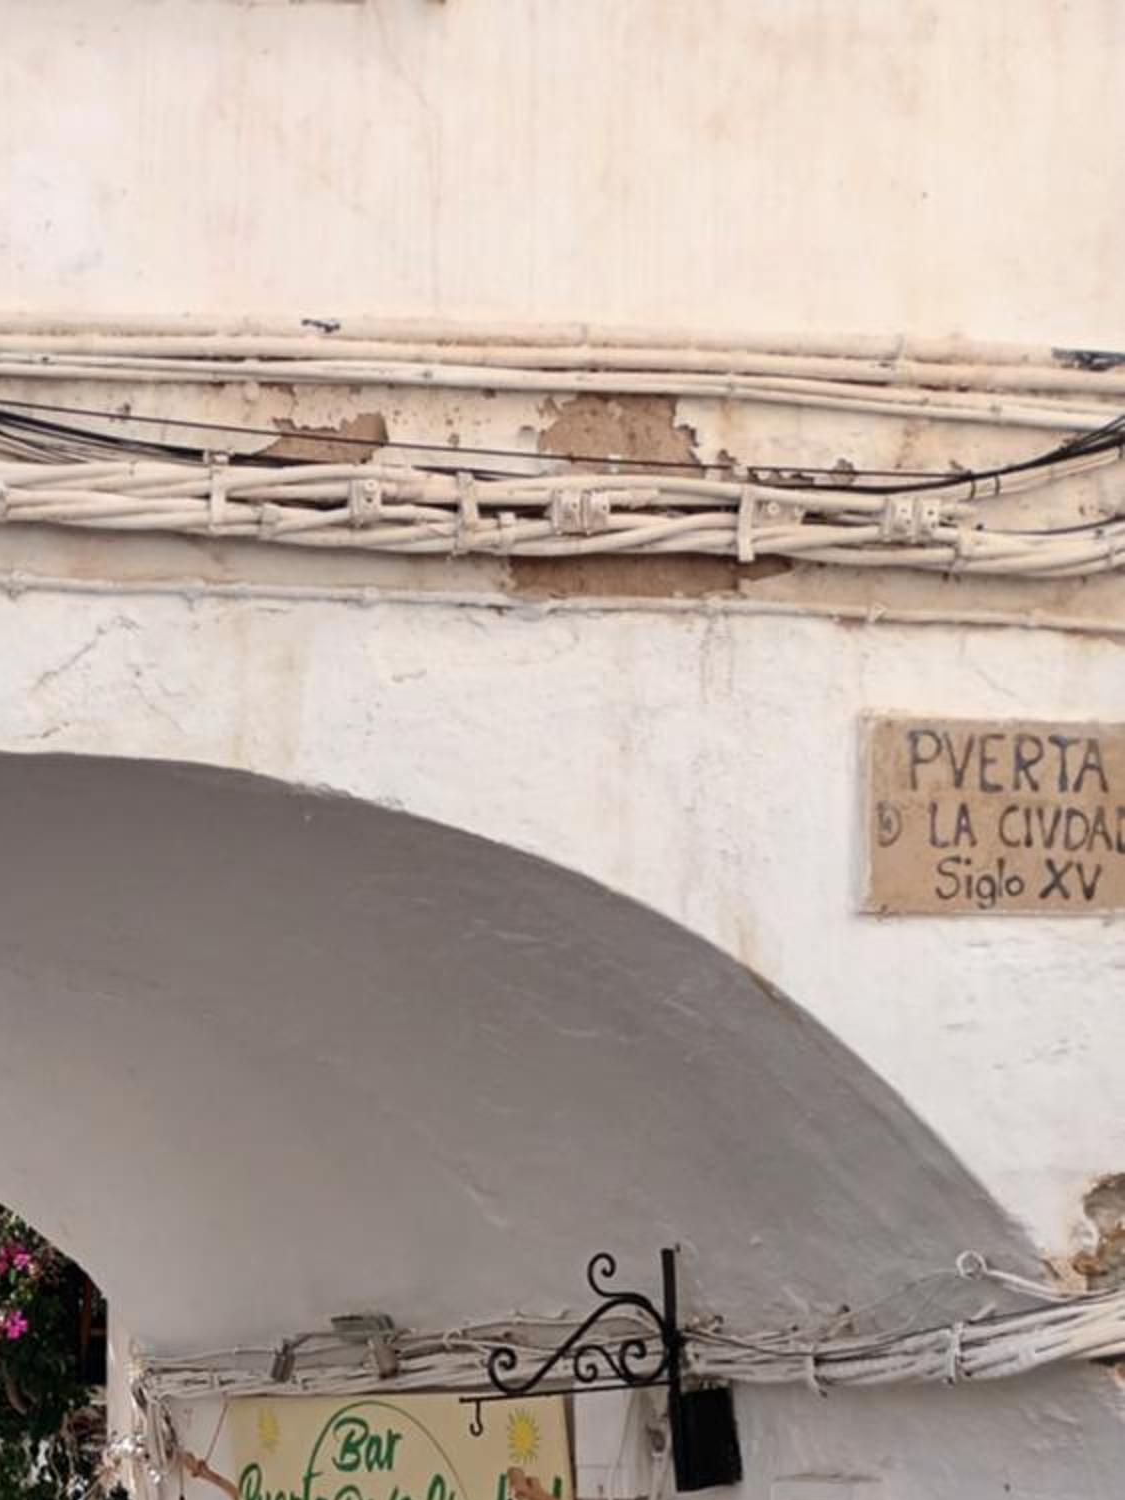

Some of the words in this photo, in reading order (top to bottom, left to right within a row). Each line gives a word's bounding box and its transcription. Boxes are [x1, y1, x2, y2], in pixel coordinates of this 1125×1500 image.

[906, 729, 1109, 793] PVERTA
[928, 802, 978, 848] LA
[935, 855, 1025, 909] Siglo
[1039, 858, 1103, 901] XV
[331, 1416, 403, 1472] Bar
